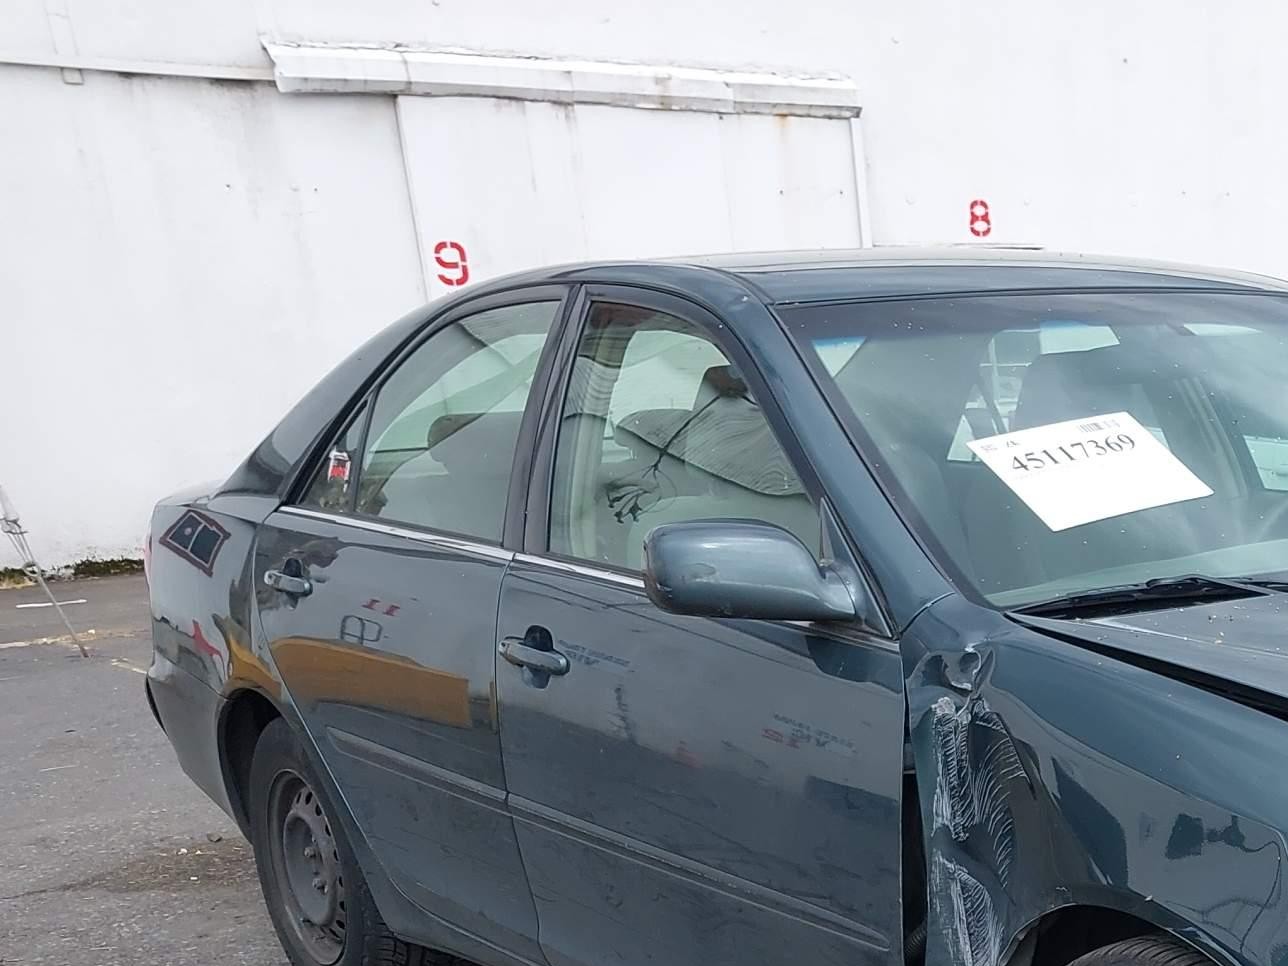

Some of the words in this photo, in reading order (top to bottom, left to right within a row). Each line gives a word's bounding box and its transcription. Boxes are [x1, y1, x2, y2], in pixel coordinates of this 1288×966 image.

[968, 199, 992, 238] 8
[434, 241, 469, 286] 9
[1011, 432, 1135, 473] 45117369
